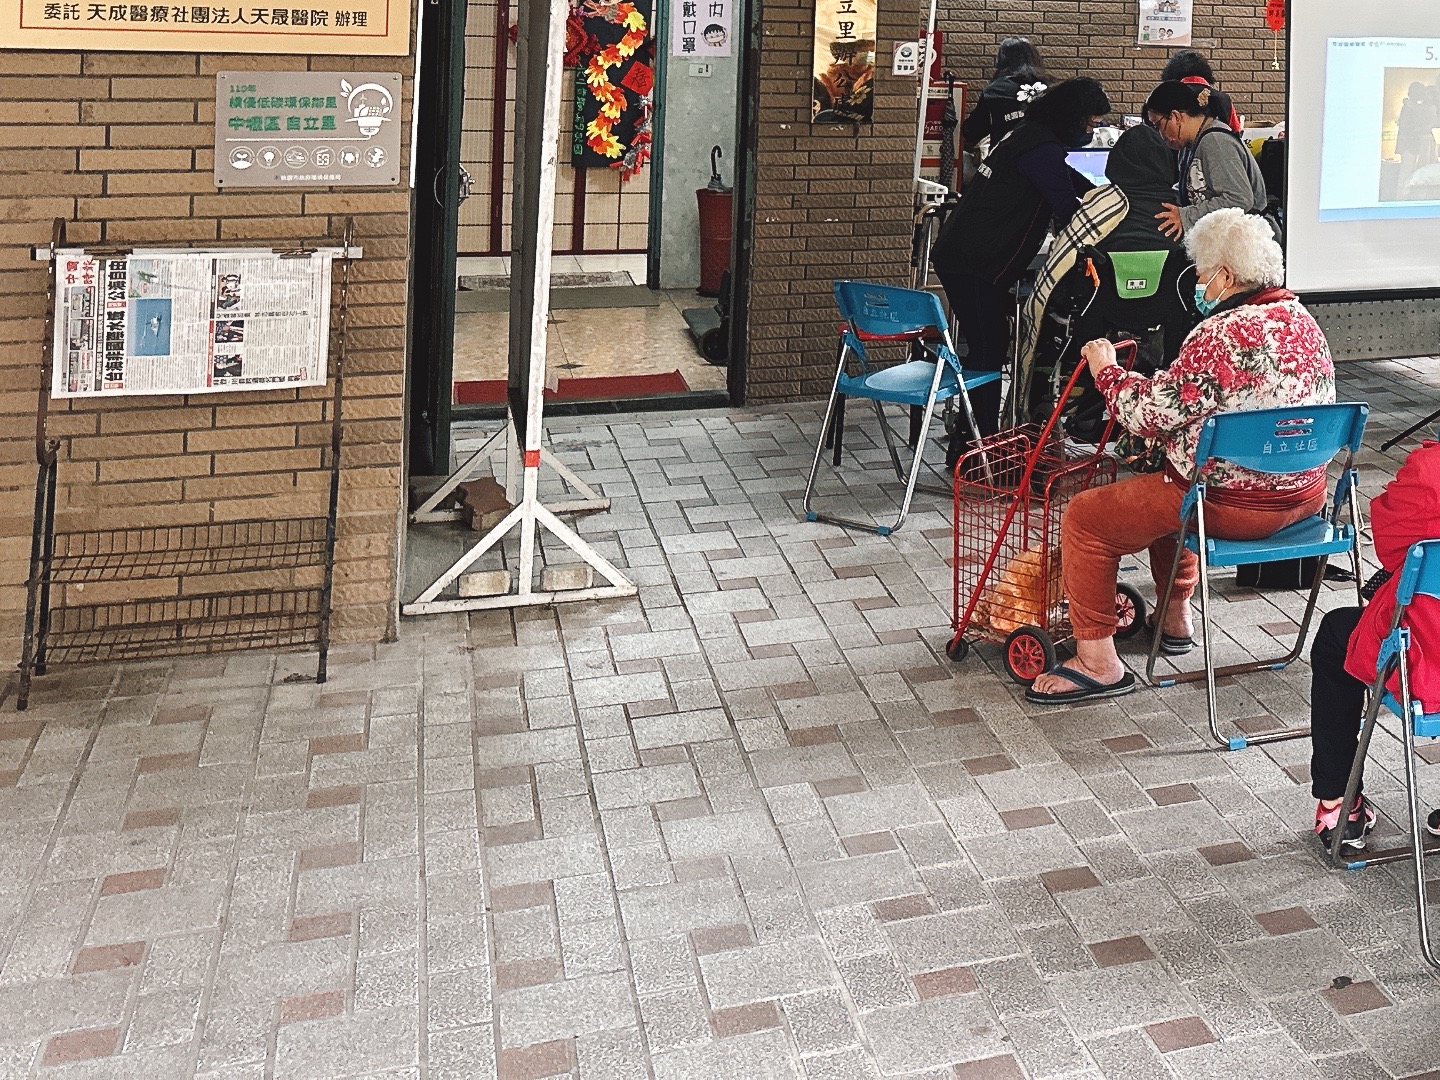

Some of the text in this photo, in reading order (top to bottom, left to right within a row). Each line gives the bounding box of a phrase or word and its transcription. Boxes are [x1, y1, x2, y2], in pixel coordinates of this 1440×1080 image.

[44, 2, 368, 27] 委託 天成醫療社團法人天晟醫院 辦理
[1425, 46, 1438, 61] 5.
[286, 115, 337, 131] 自立里
[1262, 438, 1319, 454] 自立社區
